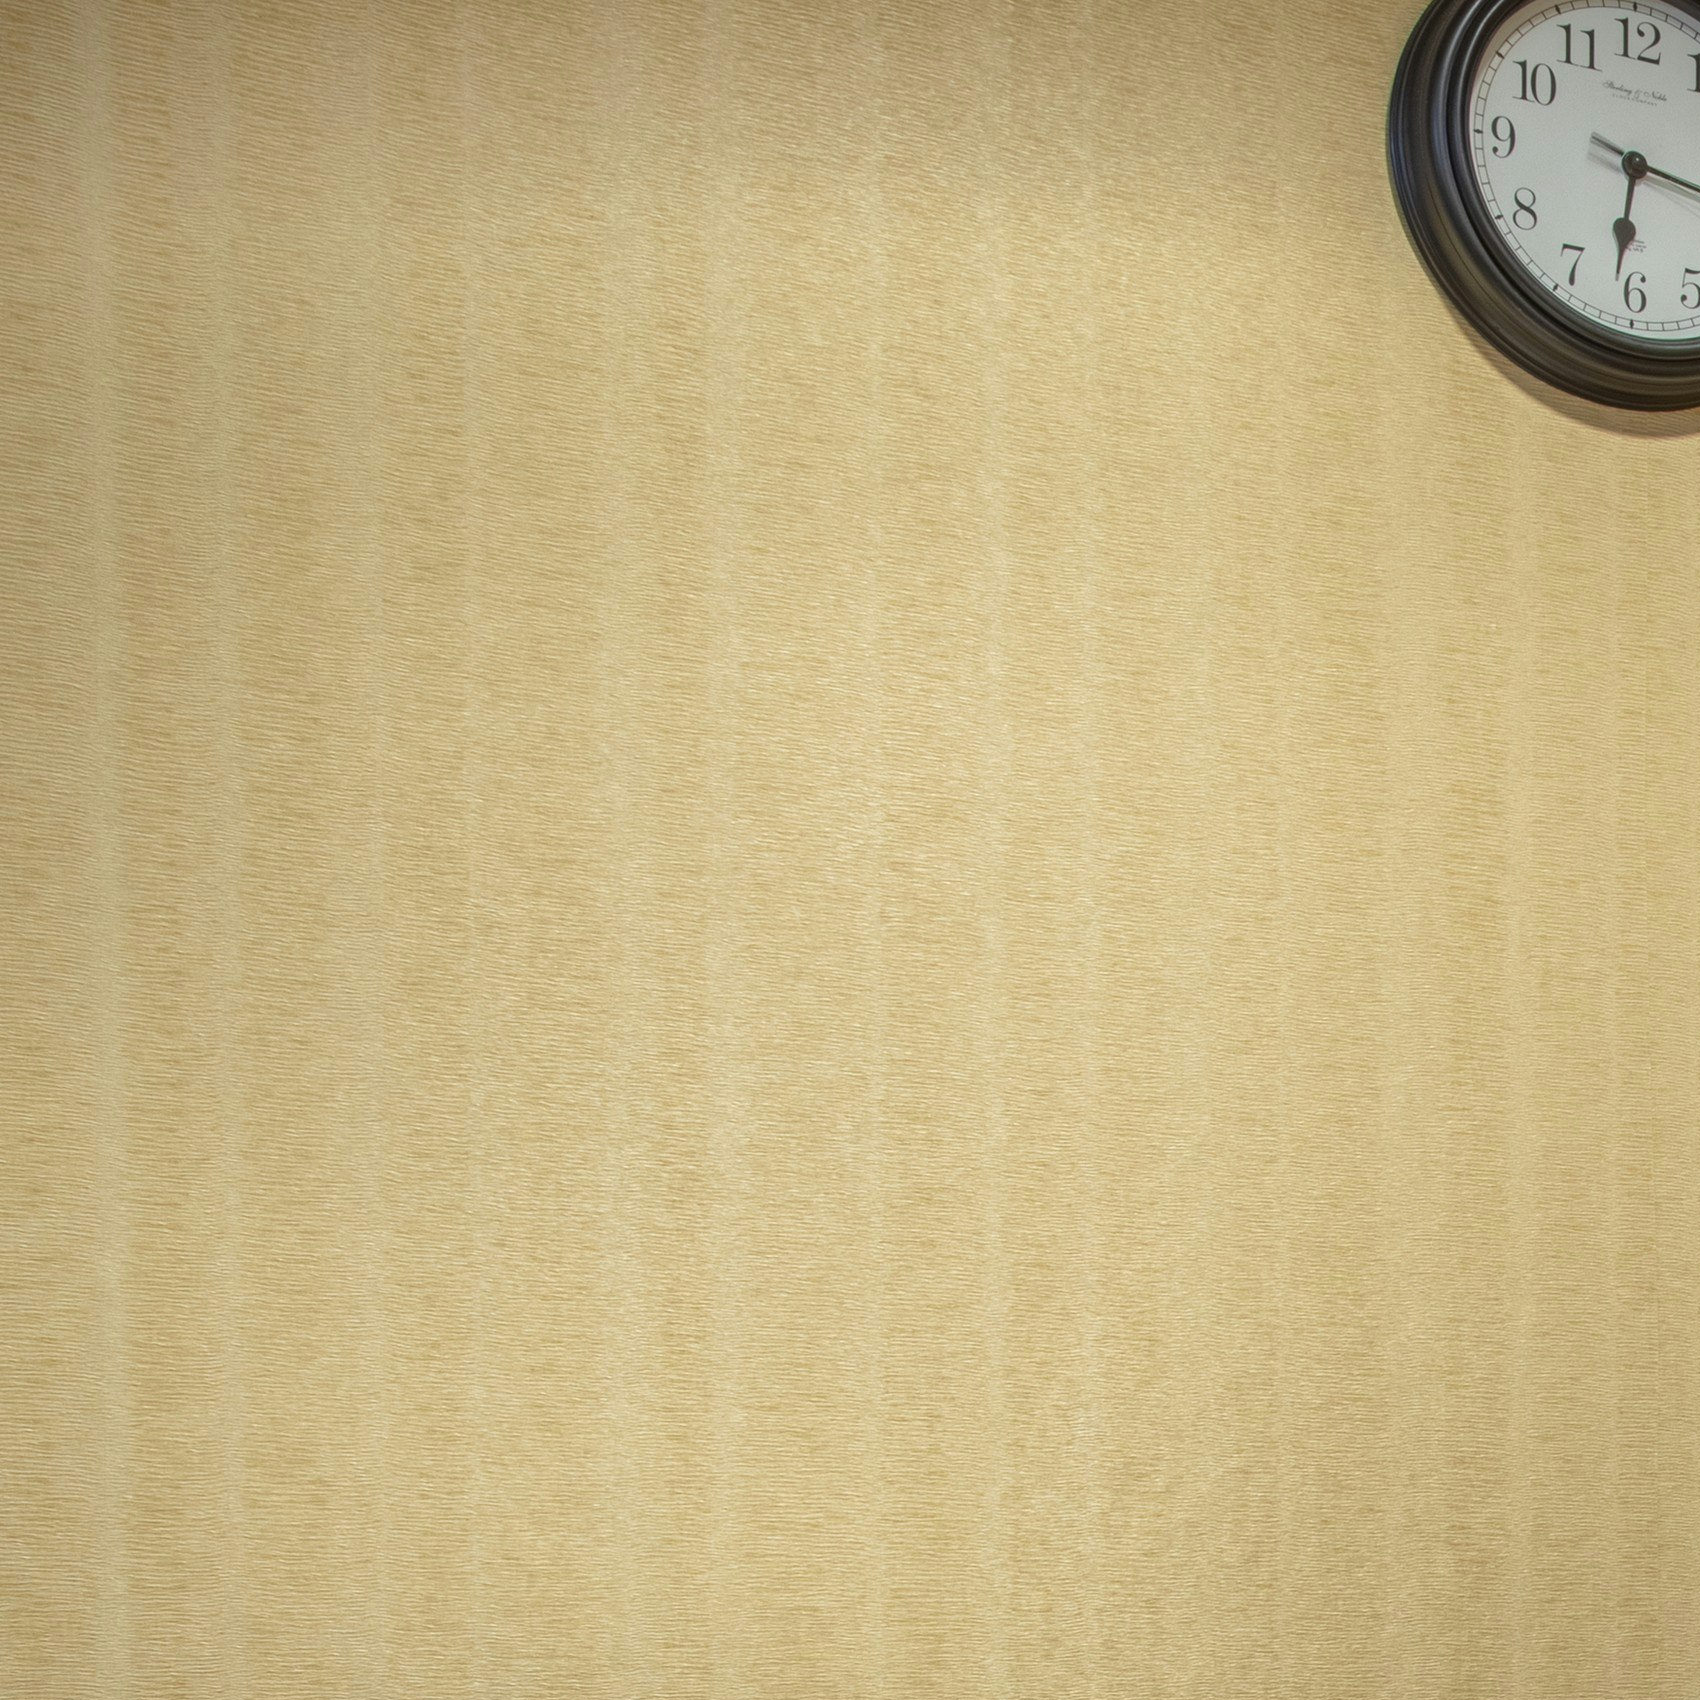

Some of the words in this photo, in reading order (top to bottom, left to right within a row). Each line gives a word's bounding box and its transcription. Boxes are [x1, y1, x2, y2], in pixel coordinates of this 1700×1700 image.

[1557, 24, 1602, 71] 11
[1614, 17, 1661, 65] 12
[1513, 59, 1557, 106] 10
[1491, 115, 1516, 158] 9
[1513, 187, 1537, 230] 8
[1561, 244, 1585, 286] 7
[1624, 272, 1647, 313] 6
